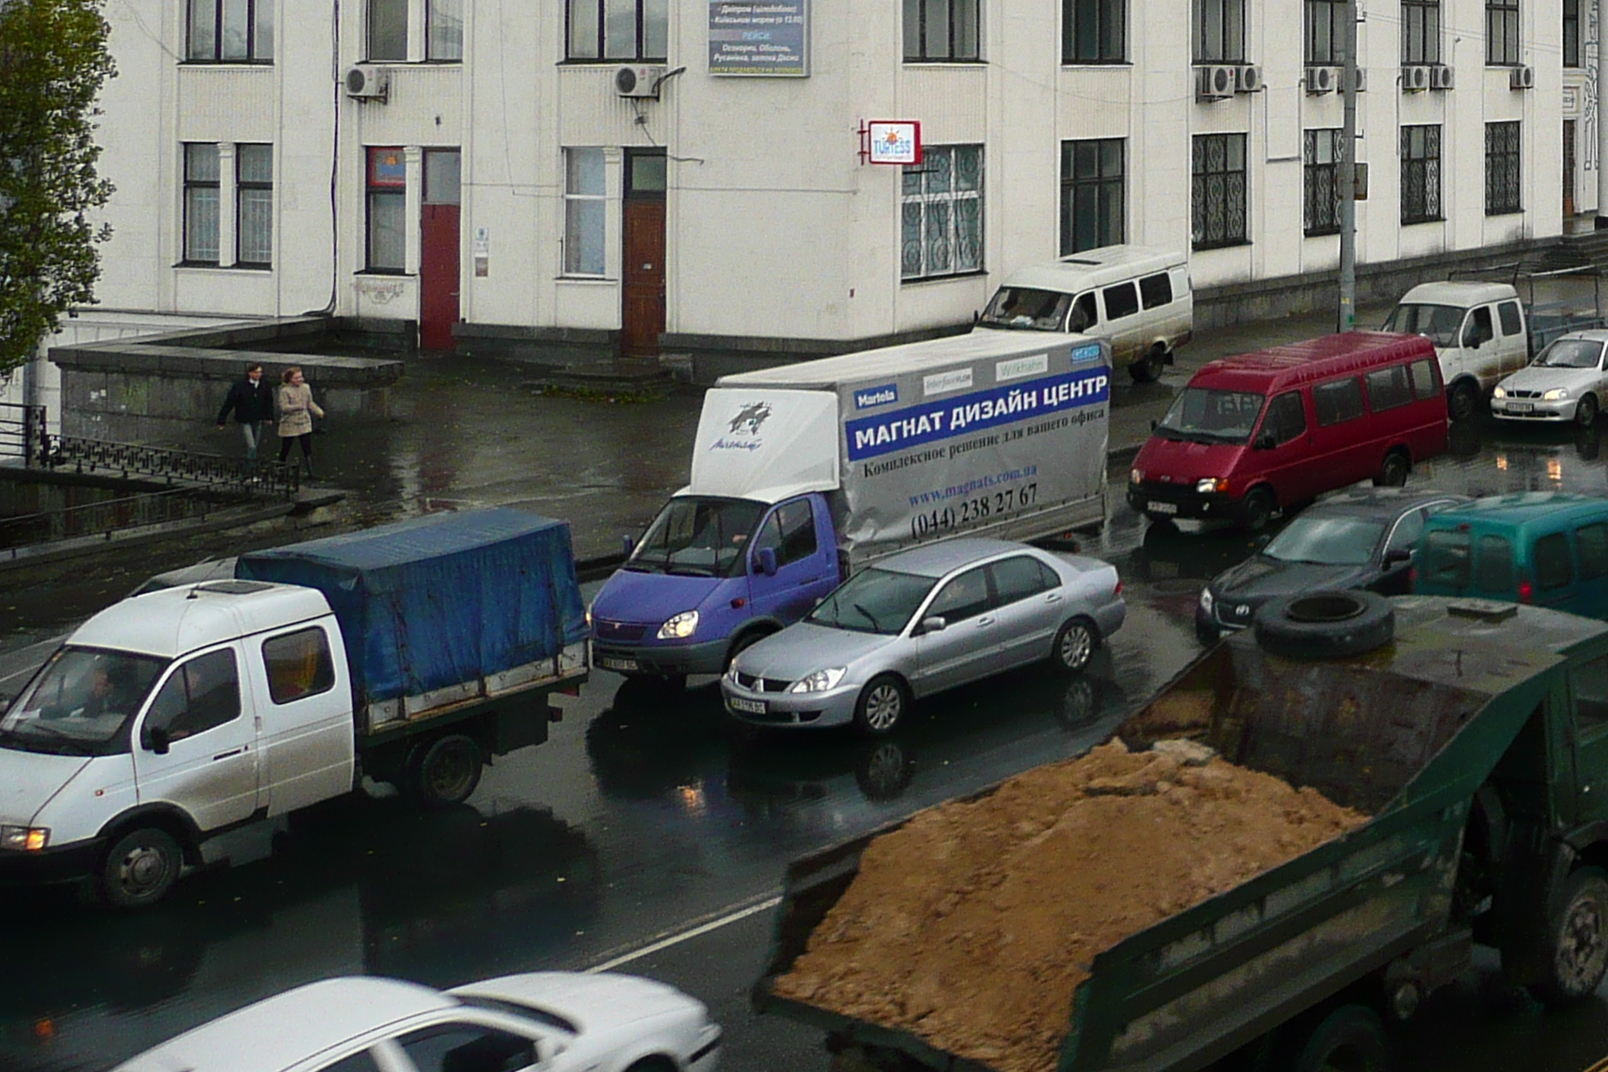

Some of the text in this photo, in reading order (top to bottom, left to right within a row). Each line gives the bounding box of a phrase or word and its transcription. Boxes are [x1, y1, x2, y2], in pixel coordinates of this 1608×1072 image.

[854, 375, 1107, 450] МАГНАТ ДИЗАЙН ЦЕНТР
[863, 408, 1104, 478] Комплексное решение для вашего офиса
[908, 464, 1038, 508] www.magnats.com.ua
[911, 483, 1038, 539] (044) 238 27 67
